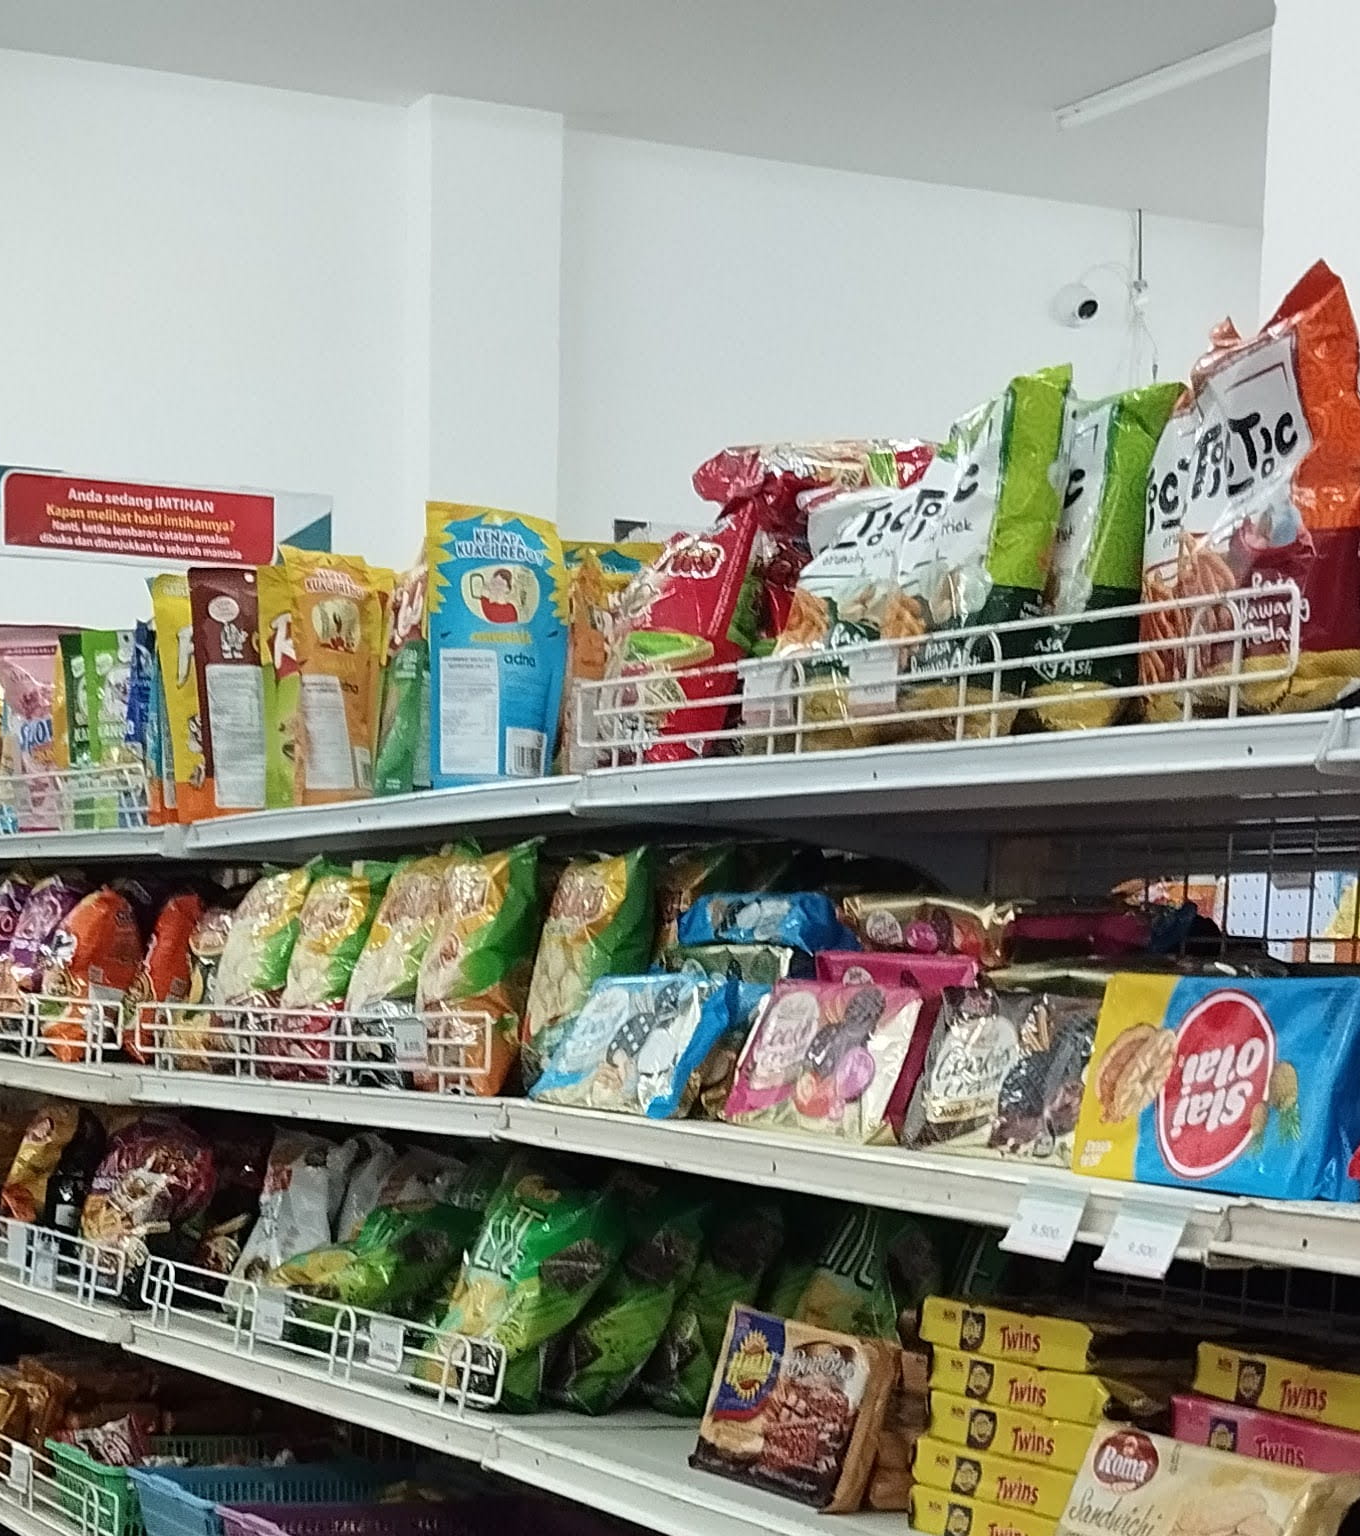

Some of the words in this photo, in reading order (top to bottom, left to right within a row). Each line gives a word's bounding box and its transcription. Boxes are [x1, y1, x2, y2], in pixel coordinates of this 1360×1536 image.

[68, 488, 103, 503] Anda
[105, 493, 153, 510] sedang
[155, 495, 214, 513] IMTIHAN
[46, 503, 84, 520] Kapan
[87, 508, 133, 523] melihat
[134, 511, 162, 526] hasil
[164, 513, 236, 532] imtihannya?
[1170, 1082, 1252, 1138] Slai
[1000, 1323, 1041, 1354] Twins
[1009, 1375, 1047, 1408] Twins
[1280, 1375, 1328, 1412] Twins
[1012, 1424, 1055, 1456] Twins
[1254, 1434, 1305, 1467] Twins
[1098, 1444, 1148, 1484] Roma
[997, 1473, 1039, 1505] Twins
